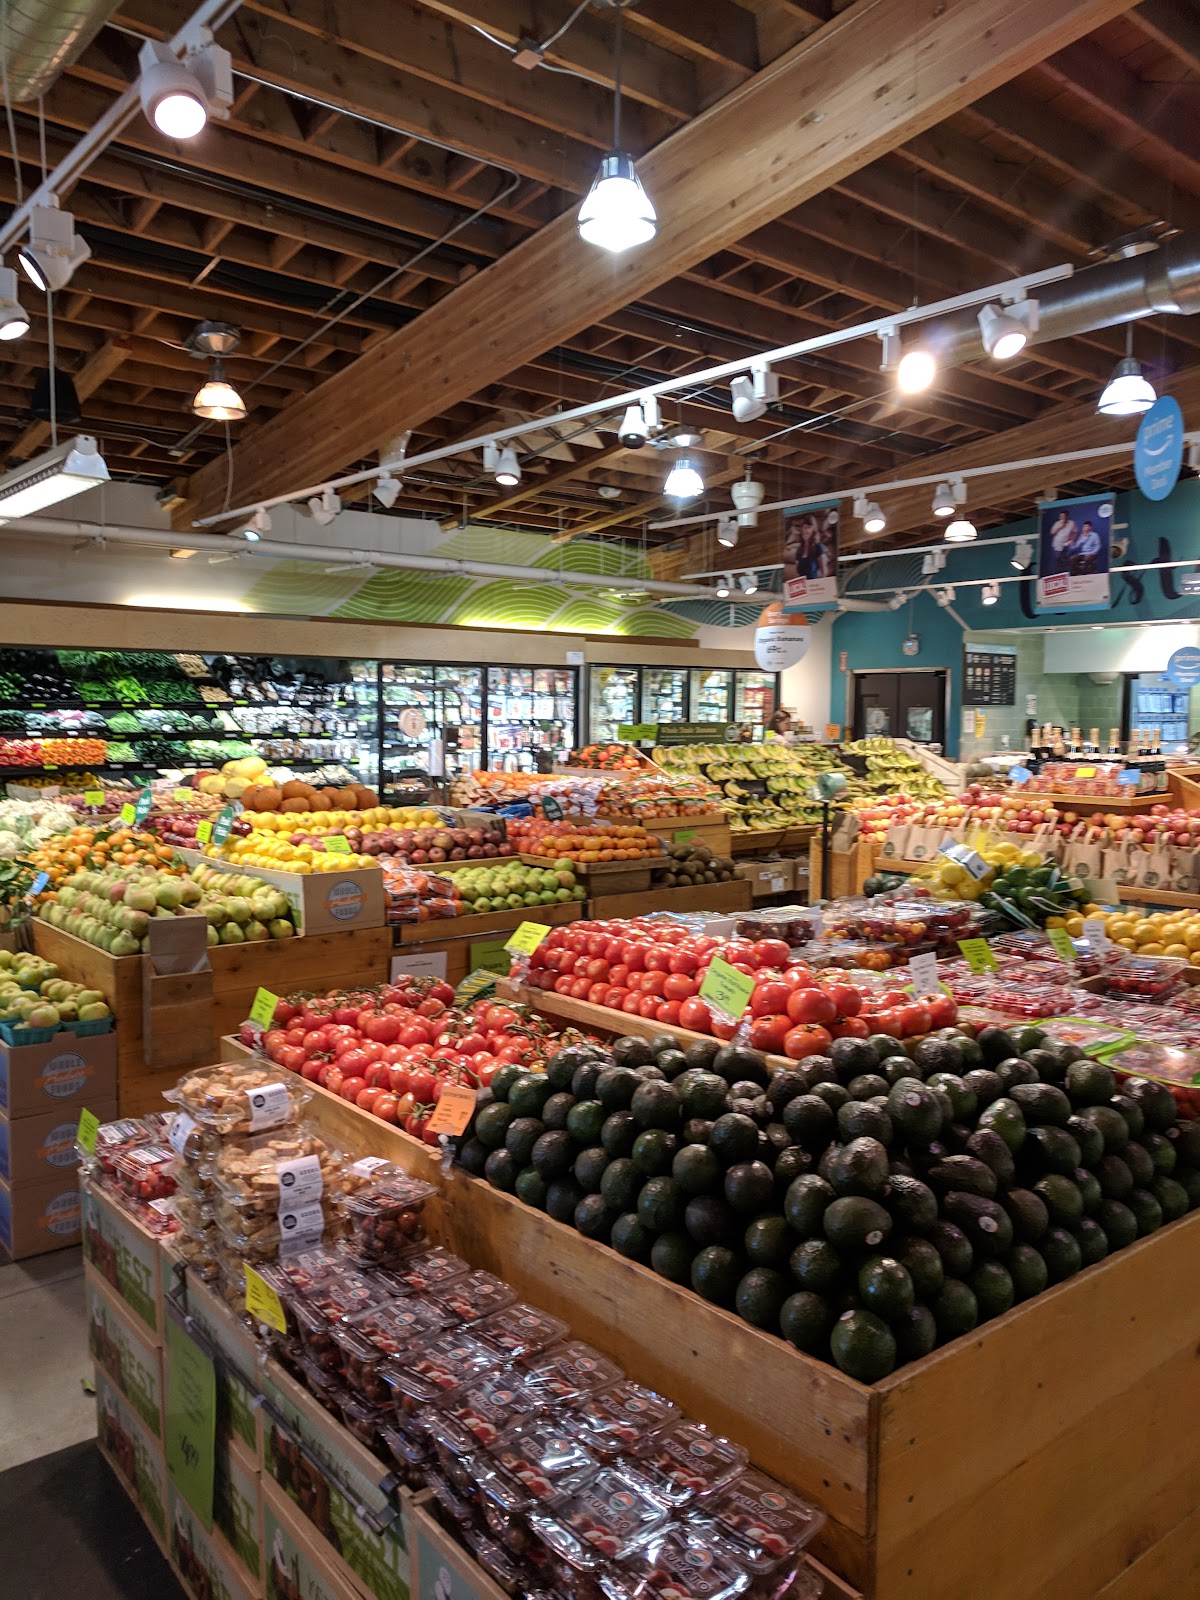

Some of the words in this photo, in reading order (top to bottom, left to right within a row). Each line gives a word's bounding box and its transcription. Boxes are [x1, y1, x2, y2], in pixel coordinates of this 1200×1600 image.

[664, 1441, 713, 1472] KUMATO
[582, 1493, 631, 1530] KUMATO
[736, 1494, 791, 1528] KUMATO
[662, 1545, 711, 1592] KUMATO
